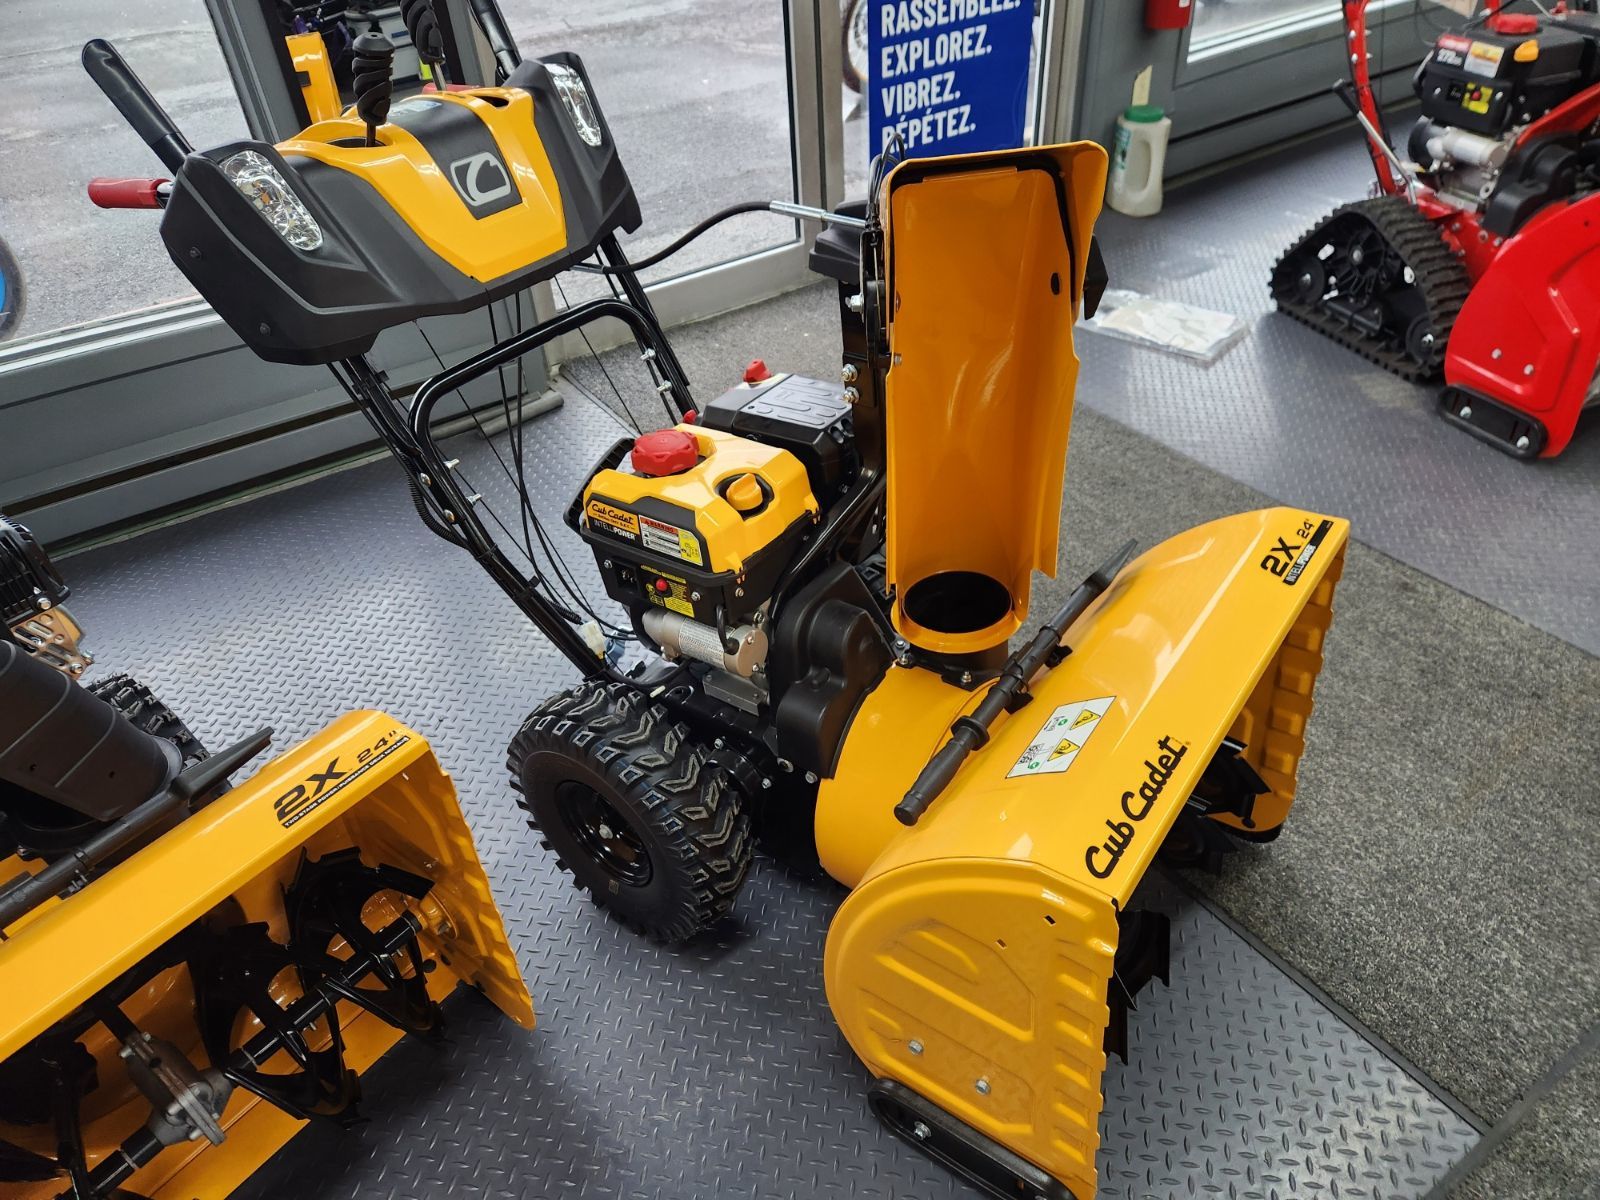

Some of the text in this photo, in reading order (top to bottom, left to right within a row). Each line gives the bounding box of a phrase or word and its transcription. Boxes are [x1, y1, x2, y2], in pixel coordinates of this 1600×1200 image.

[881, 24, 993, 79] EXPLOREZ.
[881, 71, 961, 118] VIBREZ.
[881, 104, 977, 154] RÉPÉTEZ.
[592, 503, 607, 515] Cub
[607, 510, 634, 526] Cadet
[1260, 536, 1301, 578] 2X
[274, 730, 397, 822] 2X 24"
[284, 802, 318, 827] TWO-STAGE
[1085, 735, 1189, 879] Cub Cadet
